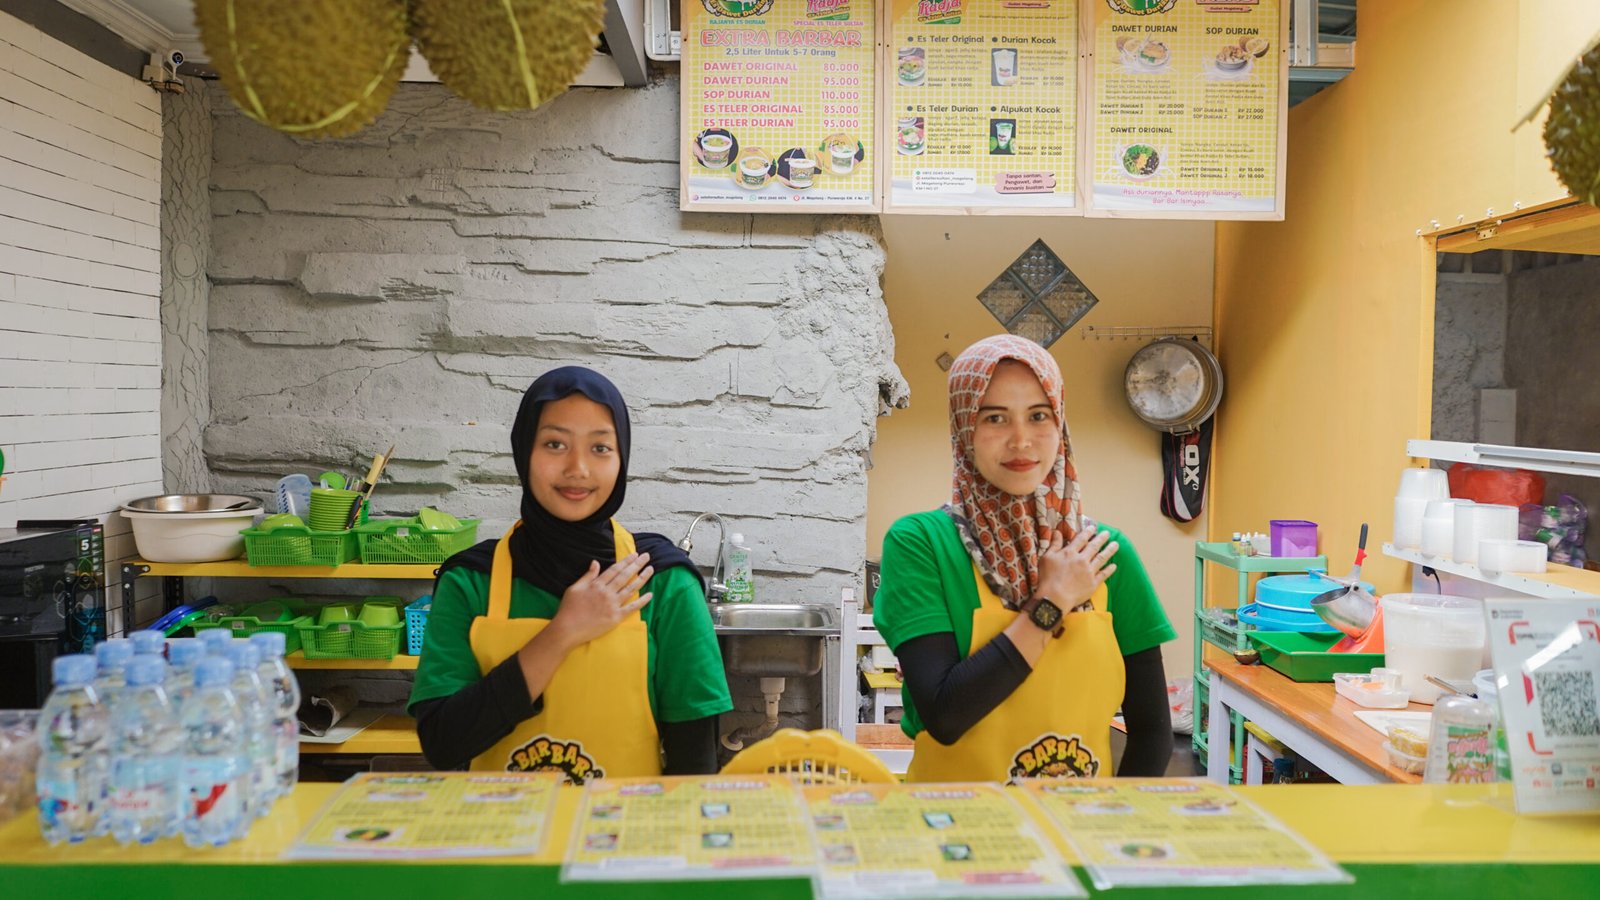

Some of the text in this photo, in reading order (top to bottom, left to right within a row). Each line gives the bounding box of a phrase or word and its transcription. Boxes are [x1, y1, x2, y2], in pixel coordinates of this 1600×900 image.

[717, 6, 741, 18] Dawet
[1121, 4, 1145, 16] Dawet
[701, 30, 862, 48] EXTRA BARBAR
[952, 36, 984, 44] Original
[726, 48, 740, 56] 2,5
[811, 49, 836, 57] Orang
[704, 62, 859, 72] DAWET ORIGINAL 80.000
[704, 76, 859, 86] DAWET DURIAN 95.000
[704, 90, 859, 100] SOP DURIAN 110.000
[704, 105, 859, 114] ES TELER ORIGINAL 85.000
[1000, 106, 1032, 114] Alpukat
[704, 118, 859, 128] ES TELER DURIAN 95.000
[81, 539, 90, 551] 5
